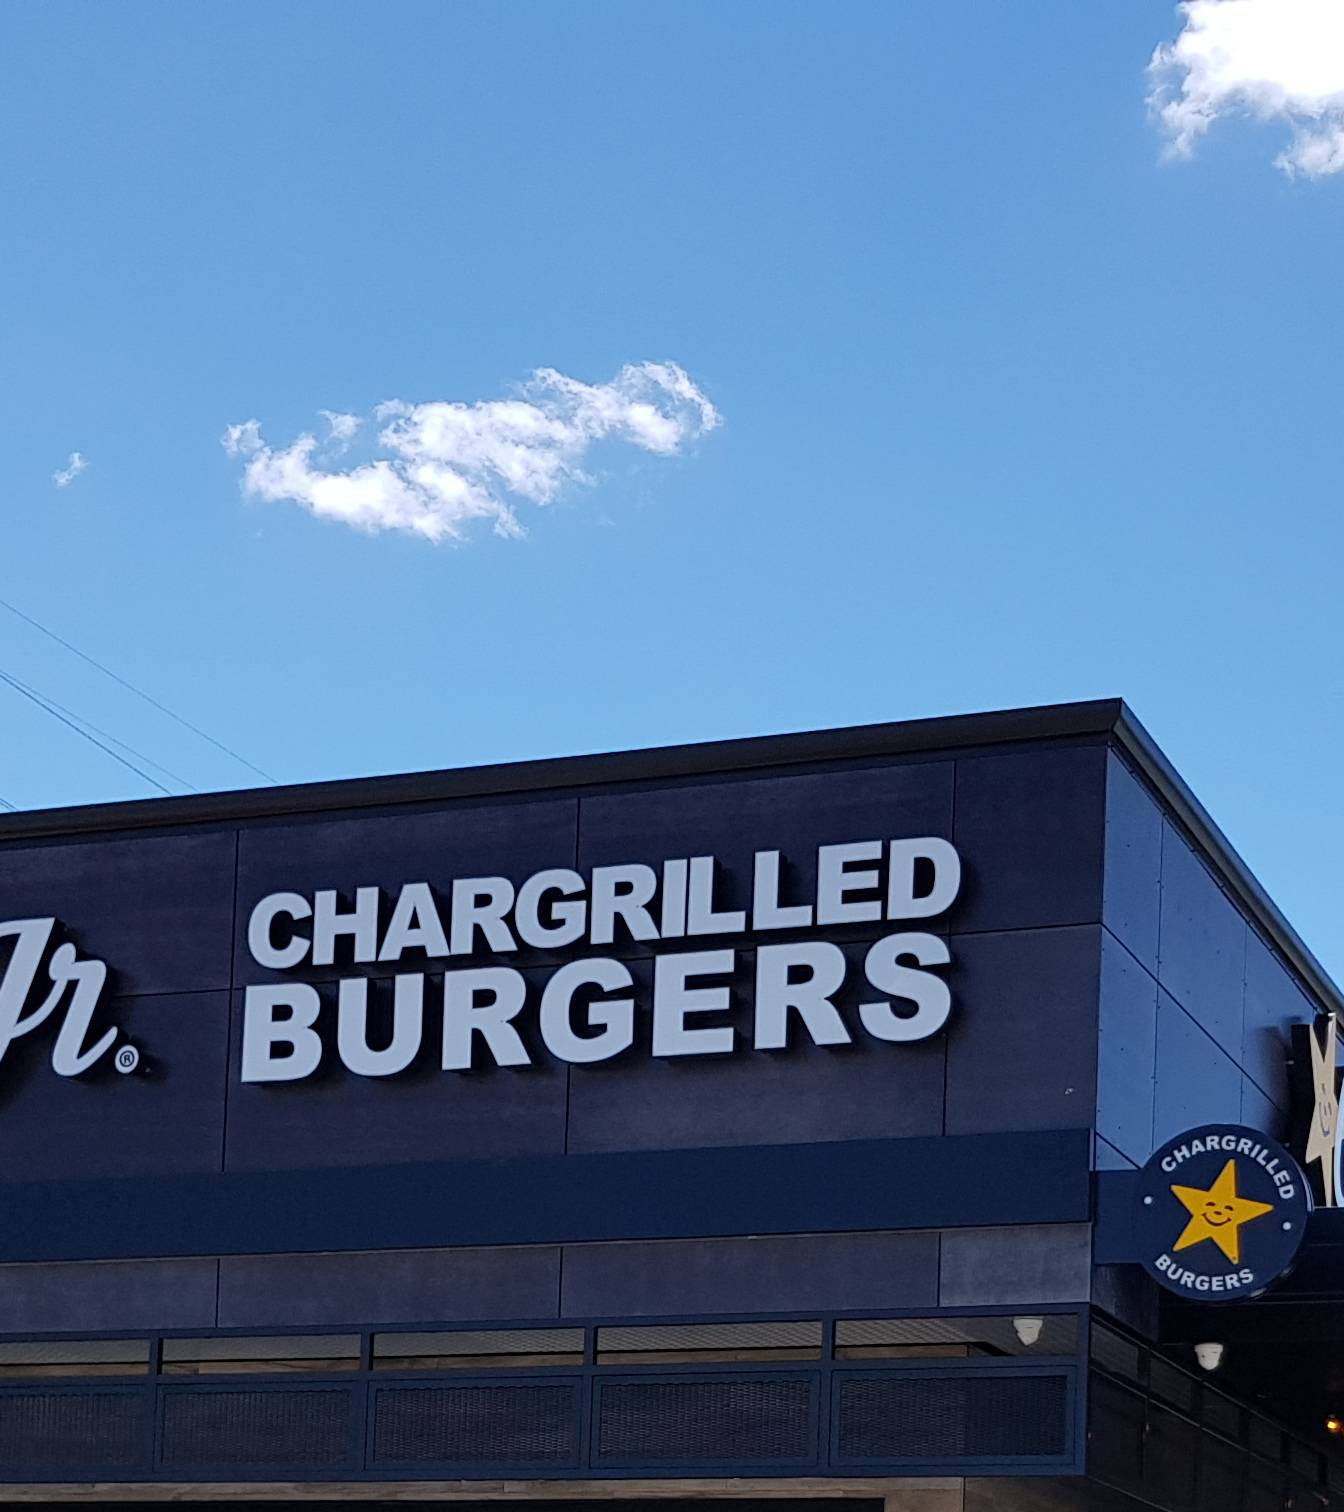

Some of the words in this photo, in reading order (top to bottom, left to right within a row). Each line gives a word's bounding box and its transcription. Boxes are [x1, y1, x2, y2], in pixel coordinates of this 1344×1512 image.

[246, 836, 962, 970] CHARGRILLED
[240, 931, 952, 1083] BURGERS
[1160, 1134, 1295, 1201] CHARGRILLED
[1155, 1253, 1255, 1292] BURGERS
